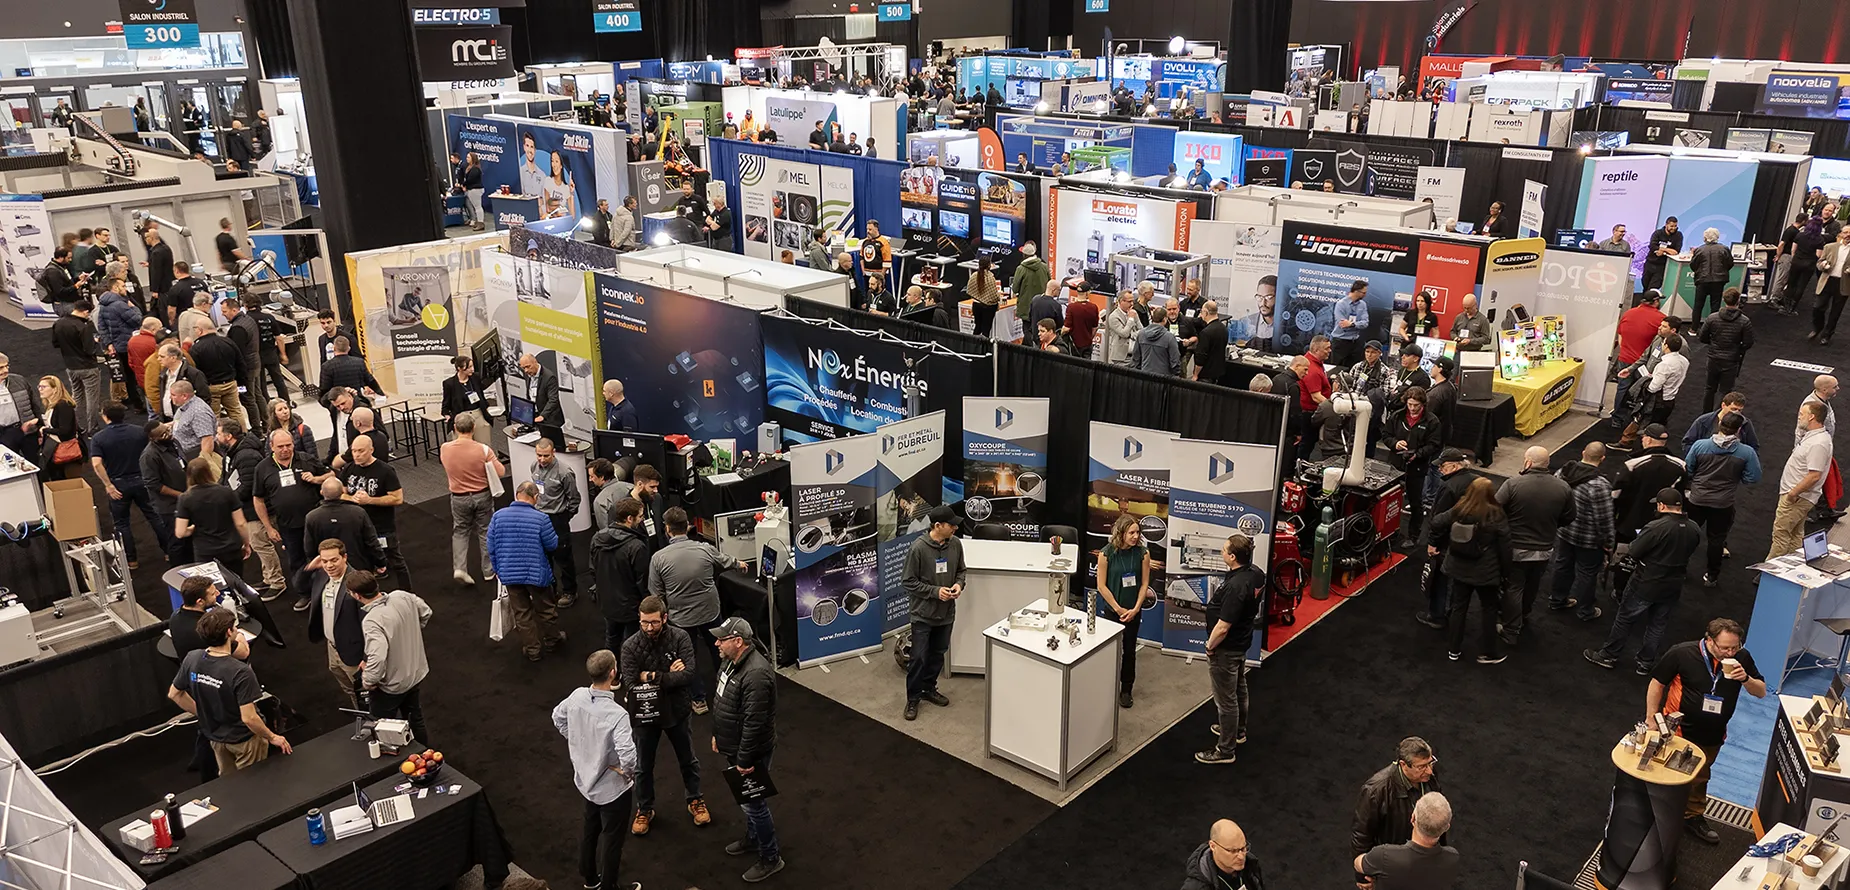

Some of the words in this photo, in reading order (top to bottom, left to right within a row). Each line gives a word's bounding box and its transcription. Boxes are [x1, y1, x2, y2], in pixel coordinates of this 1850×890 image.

[1091, 0, 1104, 10] 600
[886, 6, 902, 17] 500
[606, 14, 630, 27] 400
[1431, 11, 1449, 35] Salons
[144, 27, 181, 42] 300
[670, 64, 702, 79] SEPM
[1164, 62, 1196, 72] DVOLU
[1430, 62, 1464, 72] MALLE
[1773, 78, 1832, 88] noovelia
[770, 106, 804, 120] Latulippe
[466, 121, 489, 132] L'expert
[1494, 119, 1522, 127] rexroth
[460, 132, 506, 144] personnalisation
[464, 140, 472, 148] de
[472, 142, 504, 154] vêtements
[1185, 143, 1222, 160] IKO
[476, 152, 500, 162] poratifs
[1368, 154, 1420, 165] SURFACES
[789, 172, 810, 186] MEL
[1376, 176, 1417, 185] URFACES
[1427, 178, 1441, 186] FM
[1602, 170, 1638, 184] reptile
[1528, 191, 1538, 202] FM
[1100, 202, 1136, 216] Lovato
[1107, 215, 1137, 225] electric
[1178, 207, 1188, 250] TOMATION
[1321, 236, 1368, 247] AUTOMATISATION
[1368, 242, 1409, 251] INDUSTRIELLE
[1426, 254, 1470, 266] #danfossdrives50
[1496, 254, 1538, 264] BANNER
[394, 273, 440, 281] AKRONYM
[1298, 268, 1323, 277] PRODUITS
[1323, 269, 1370, 282] TECHNOLOGIQUES
[1298, 276, 1326, 286] SOLUTIONS
[1326, 279, 1352, 288] INNOVANT
[602, 284, 645, 304] iconnek.io
[1298, 284, 1318, 293] SERVICE
[1318, 286, 1348, 296] D'URGENCE
[1425, 288, 1438, 298] 50
[1296, 292, 1319, 301] SUPPORT
[1319, 294, 1343, 302] TECHNO
[604, 318, 616, 326] pour
[616, 320, 640, 332] l'industrie
[639, 326, 648, 334] 4.0
[854, 356, 928, 399] Énergie
[818, 384, 858, 403] Chaufferie
[804, 394, 838, 410] Procédés
[870, 398, 908, 415] Combusti
[850, 406, 884, 422] Location
[884, 414, 895, 424] de
[810, 421, 834, 433] SERVICE
[916, 428, 932, 436] MÉTAL
[898, 433, 941, 450] DUBREUIL
[1120, 473, 1142, 482] LASER
[1143, 476, 1150, 484] À
[1150, 478, 1170, 487] FIBRE
[798, 487, 822, 496] LASER
[806, 490, 835, 502] PROFILÉ
[1198, 502, 1227, 510] TRUBEND
[846, 550, 877, 562] PLASMA
[894, 596, 910, 605] PARTIC
[818, 628, 861, 642] www.fmd.qc.ca
